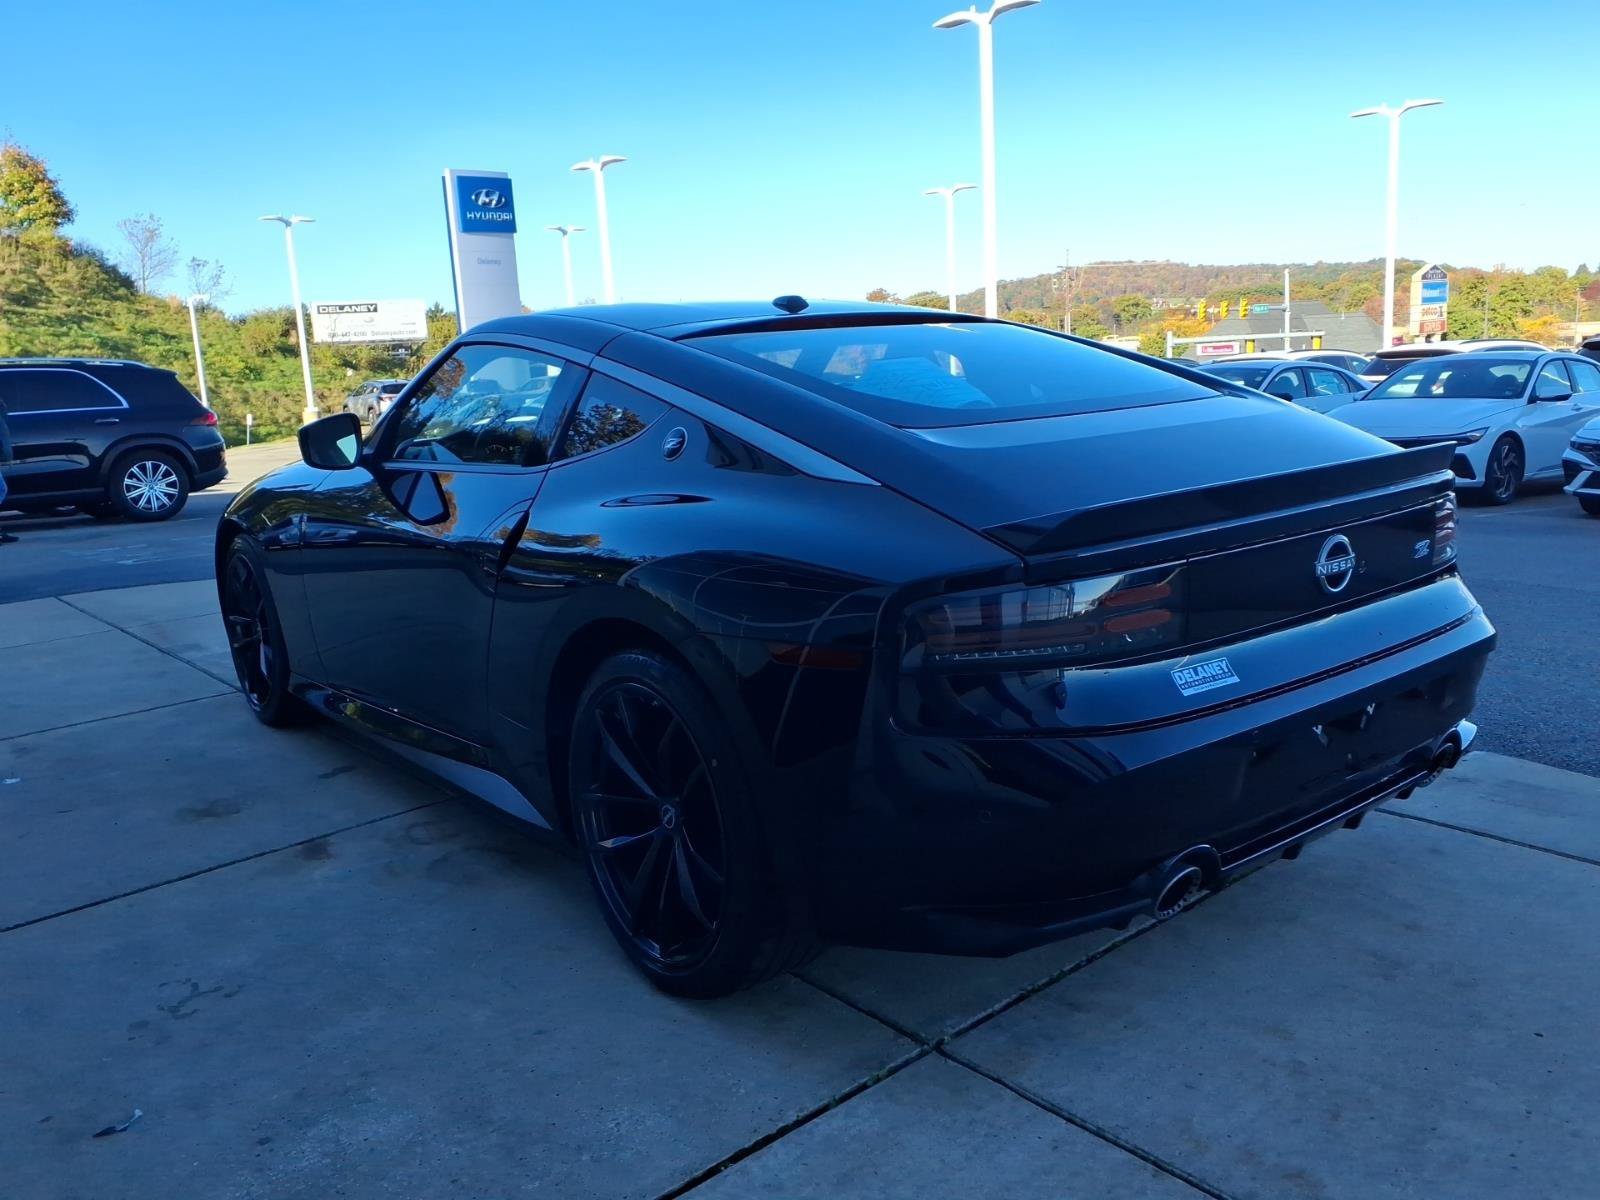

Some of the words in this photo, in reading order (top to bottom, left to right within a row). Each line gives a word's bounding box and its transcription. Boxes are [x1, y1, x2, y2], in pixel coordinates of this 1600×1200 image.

[466, 211, 513, 221] HYUNDAI
[319, 304, 376, 313] DELANEY
[1173, 660, 1229, 685] DELANEY
